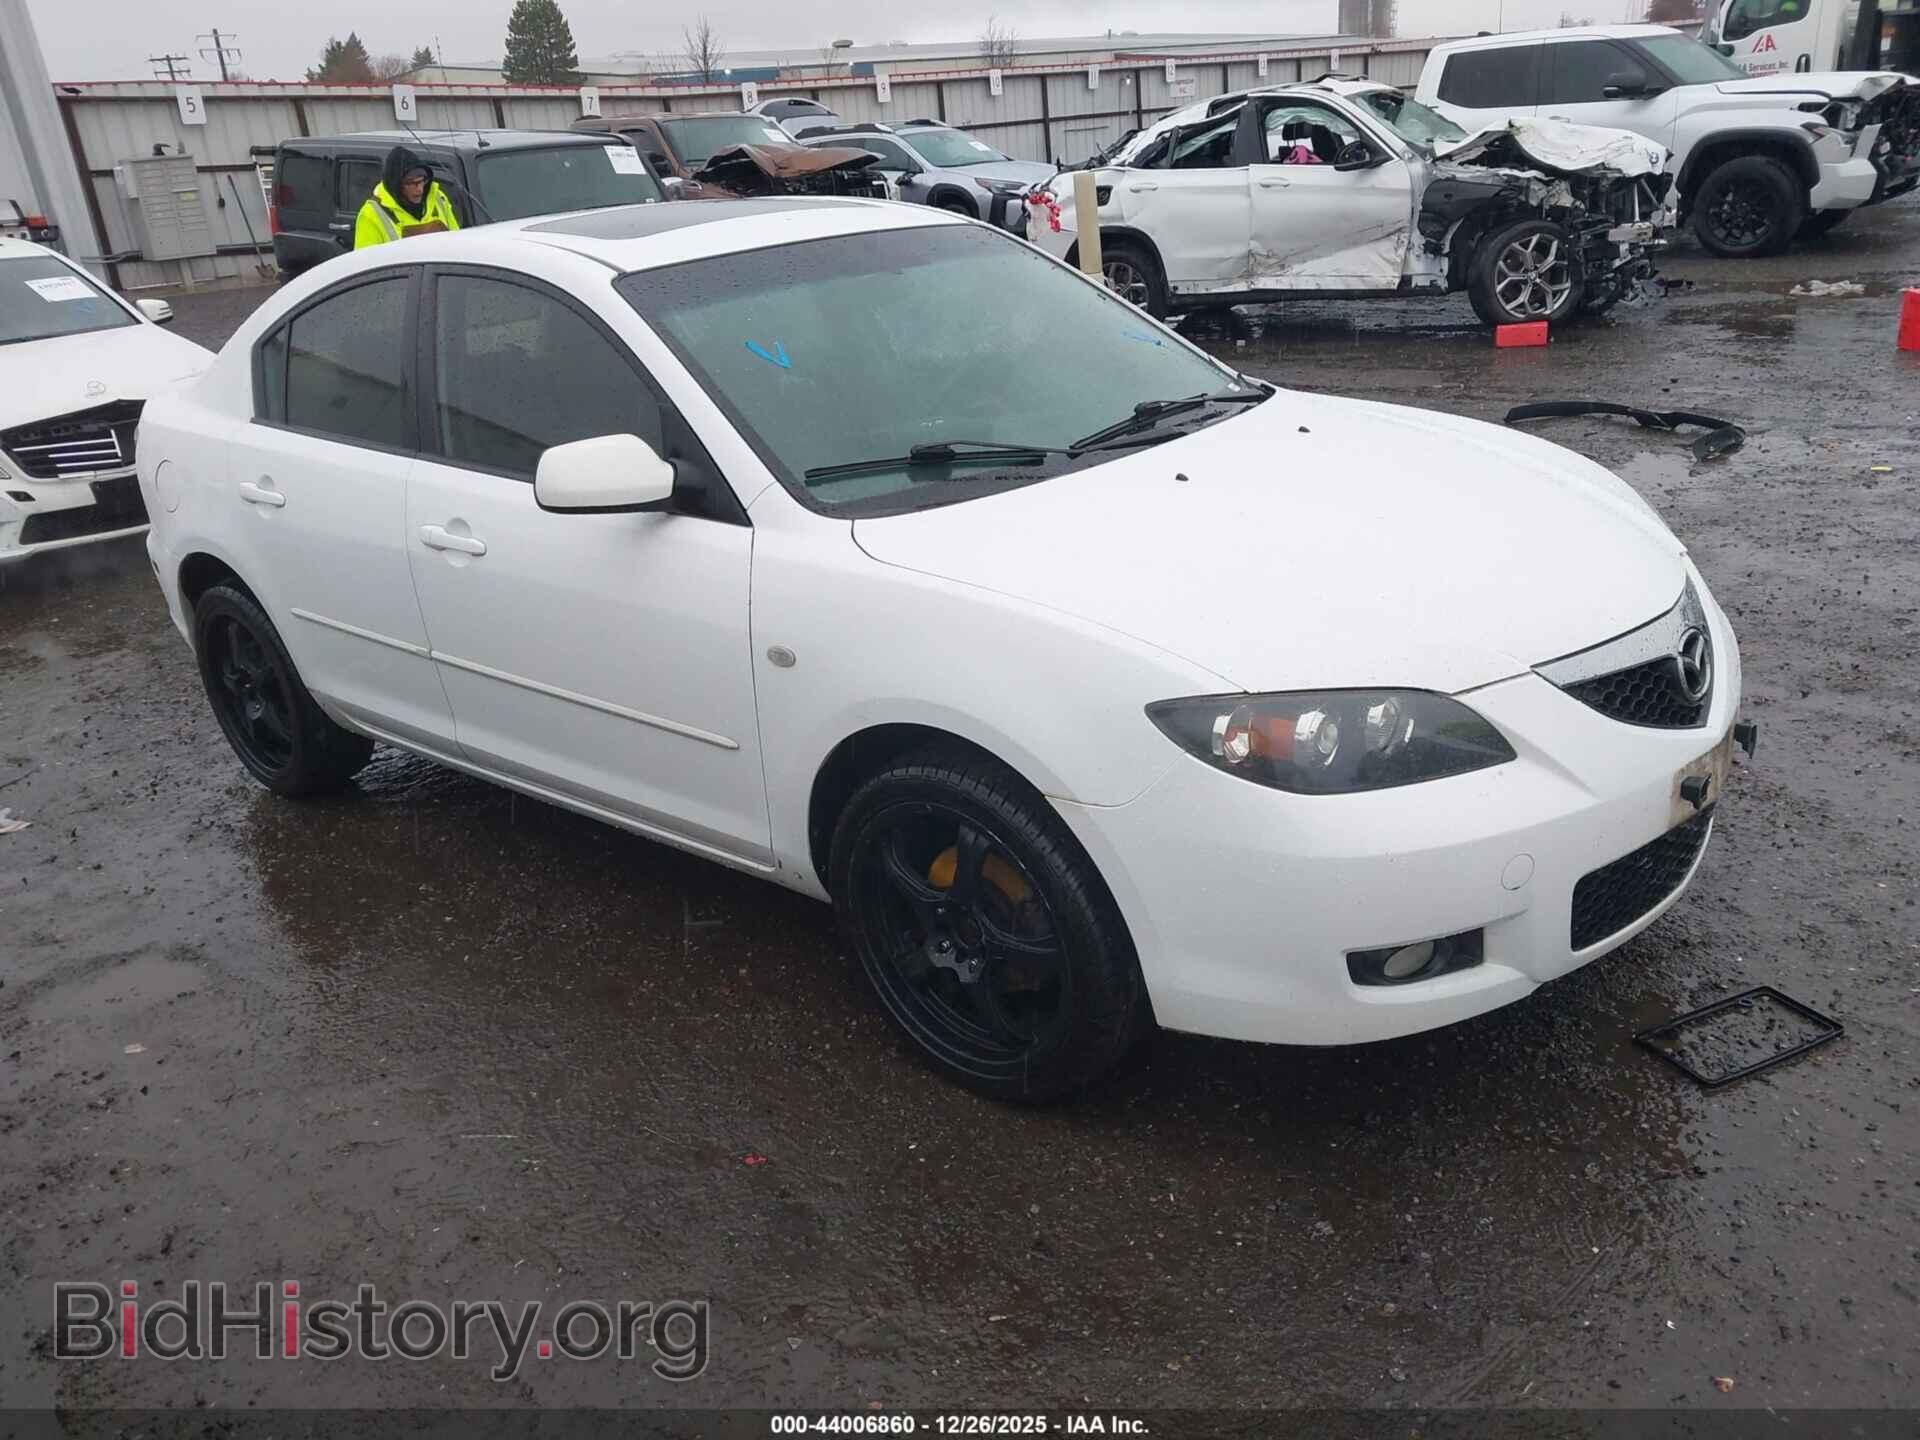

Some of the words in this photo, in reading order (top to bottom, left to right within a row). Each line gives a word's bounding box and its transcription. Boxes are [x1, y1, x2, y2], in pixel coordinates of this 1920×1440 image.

[880, 81, 887, 94] 9
[991, 74, 1001, 88] 10
[400, 95, 410, 111] 6
[587, 96, 594, 110] 7
[747, 90, 753, 104] 8
[185, 96, 197, 113] 5
